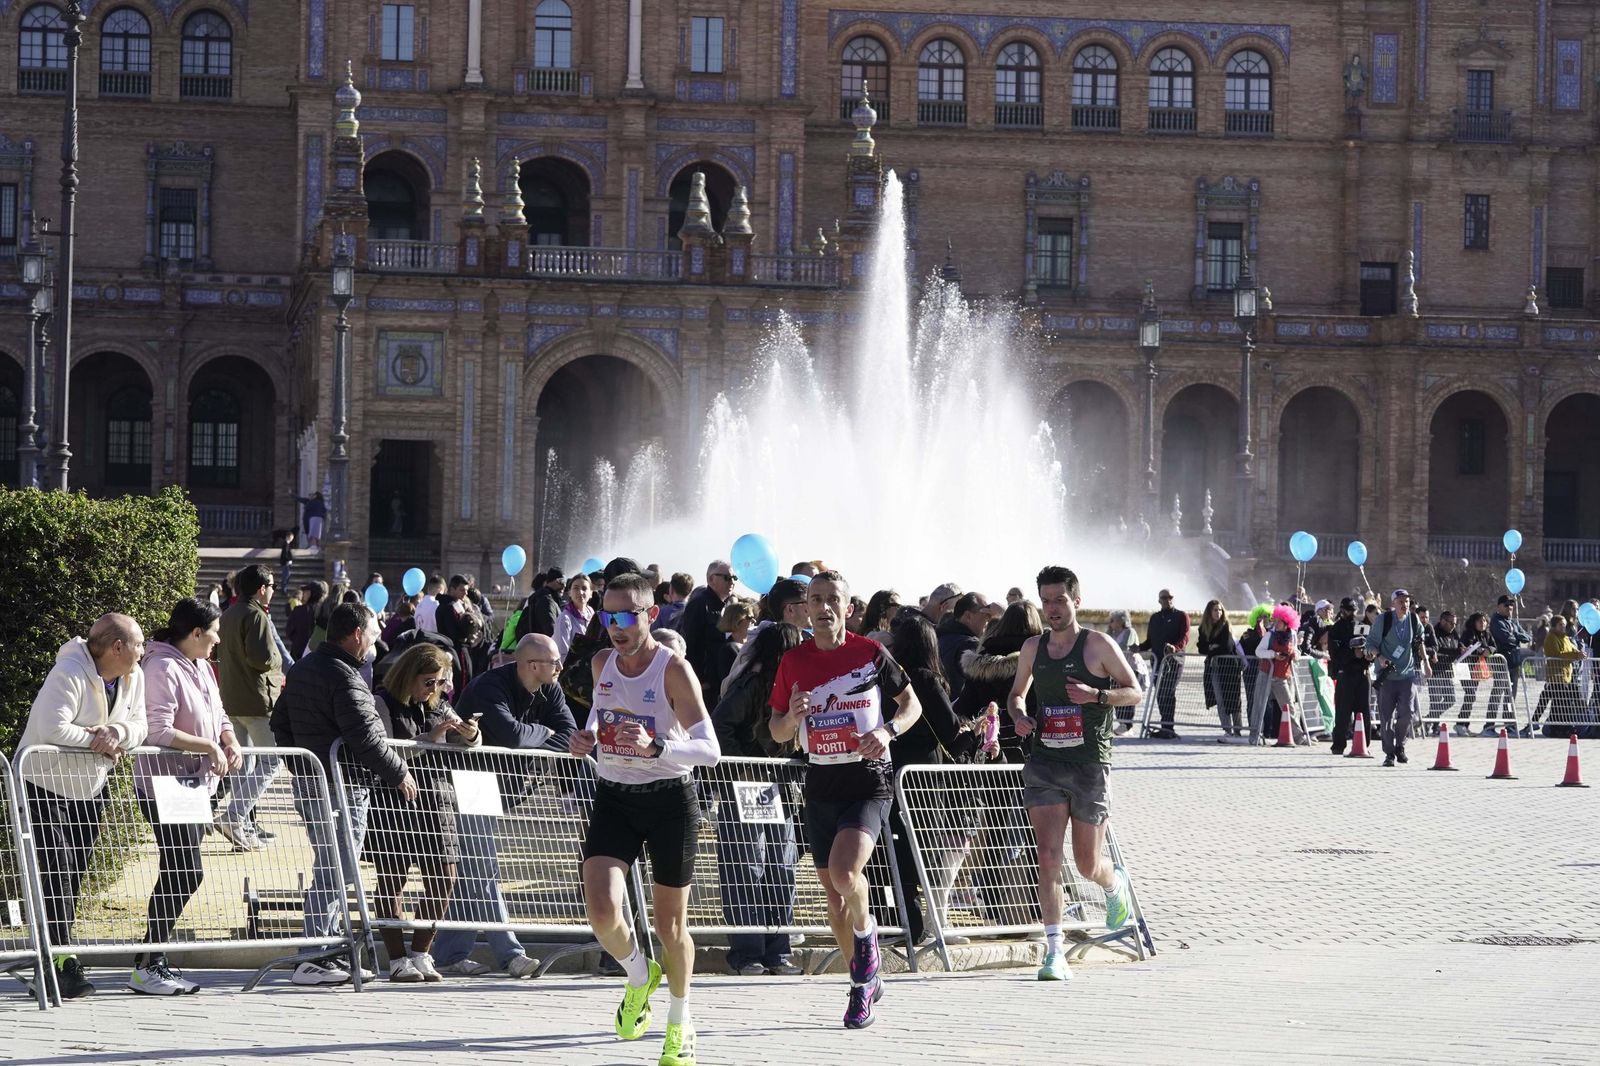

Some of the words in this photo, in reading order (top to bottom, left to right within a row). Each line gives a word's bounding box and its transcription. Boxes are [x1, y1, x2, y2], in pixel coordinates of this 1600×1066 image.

[618, 714, 648, 727] ZRICH
[818, 716, 849, 727] ZURICH
[821, 732, 839, 741] 1239
[816, 741, 847, 754] PORTI
